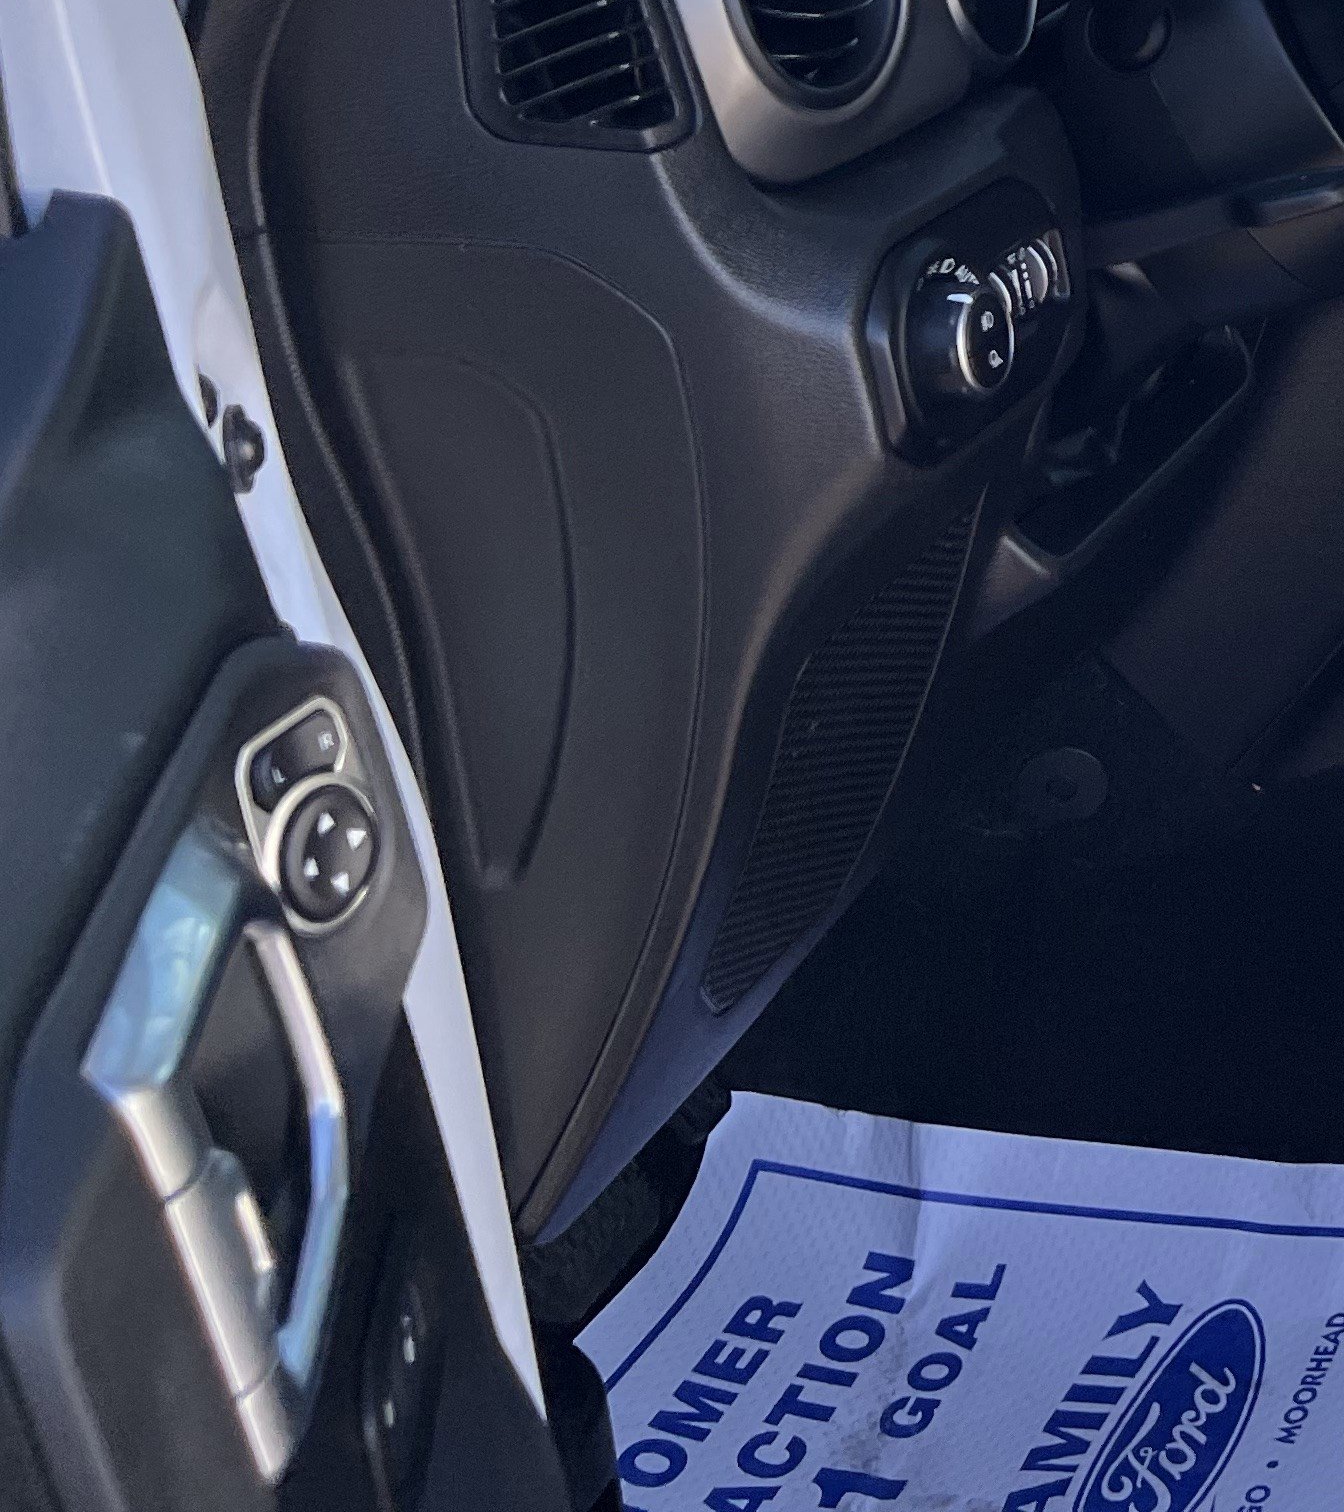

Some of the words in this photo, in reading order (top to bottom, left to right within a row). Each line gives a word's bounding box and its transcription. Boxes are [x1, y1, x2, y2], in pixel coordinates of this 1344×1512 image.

[618, 1294, 803, 1512] OMER
[878, 1263, 1007, 1438] GOAL
[1100, 1360, 1237, 1512] Ford
